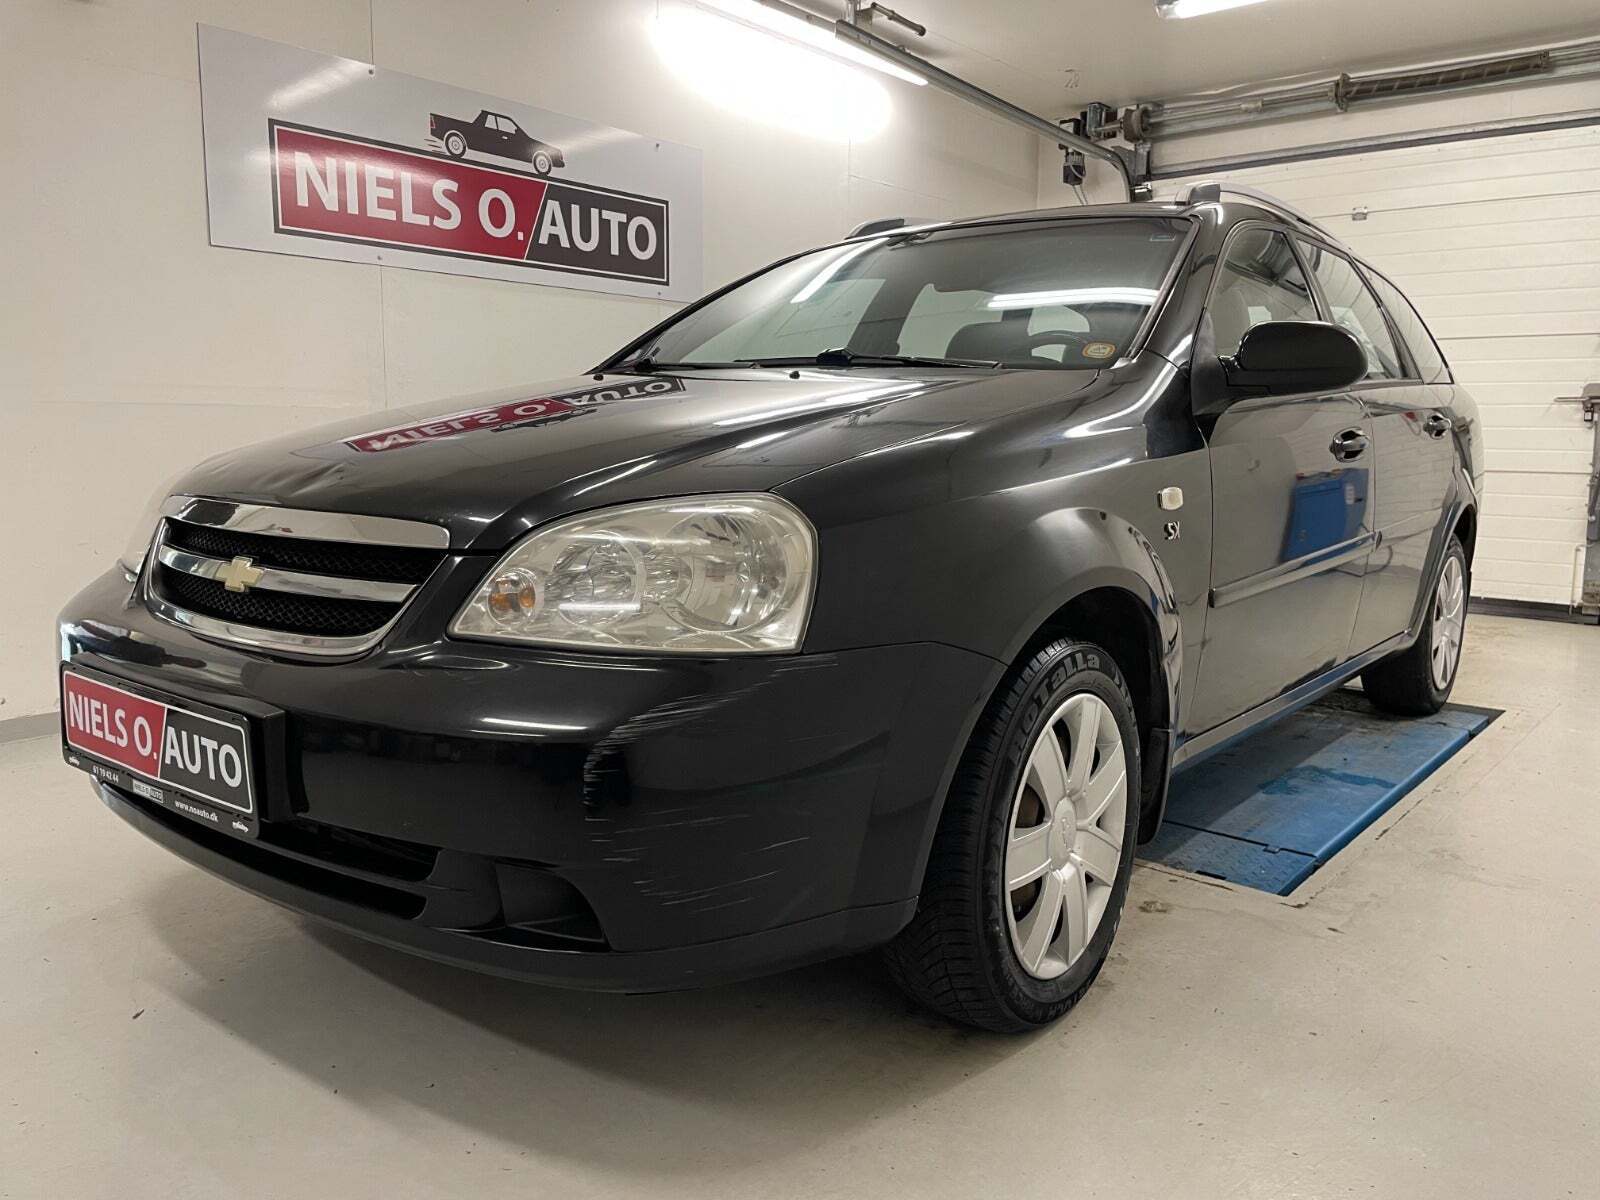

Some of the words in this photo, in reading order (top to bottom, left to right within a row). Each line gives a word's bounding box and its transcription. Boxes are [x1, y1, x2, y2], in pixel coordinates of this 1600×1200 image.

[294, 152, 461, 232] NIELS
[478, 188, 524, 241] O.
[538, 199, 657, 261] AUTO
[68, 691, 128, 748] NIELS
[133, 716, 158, 760] O.
[165, 725, 242, 788] AUTO
[174, 800, 219, 822] www.noauto.dk
